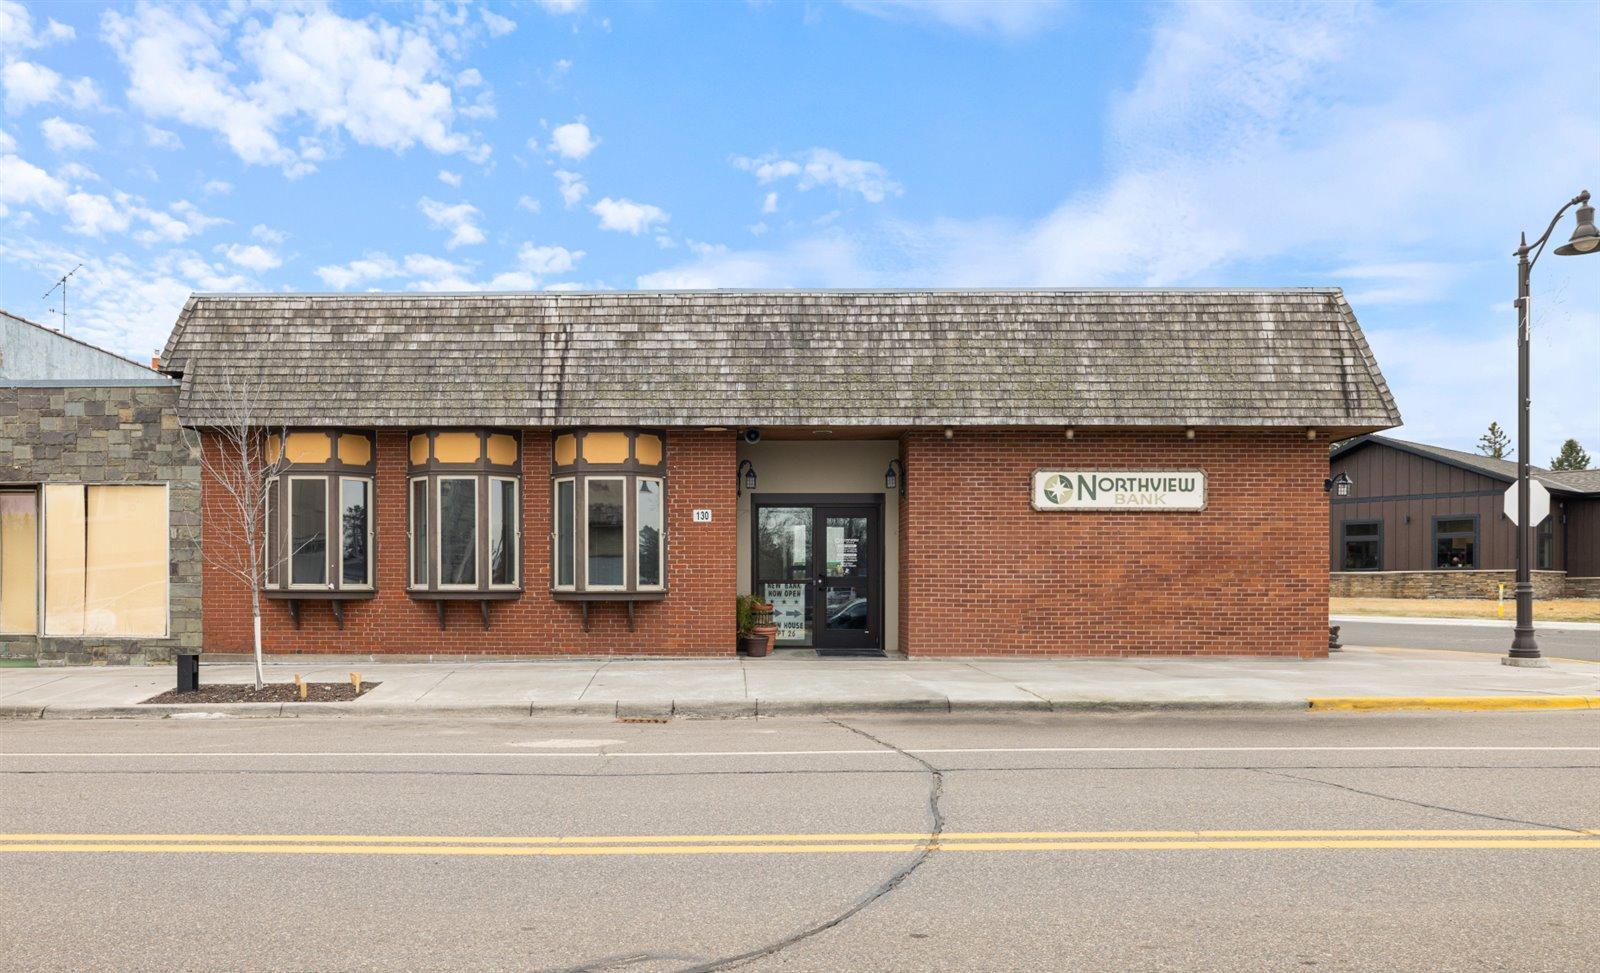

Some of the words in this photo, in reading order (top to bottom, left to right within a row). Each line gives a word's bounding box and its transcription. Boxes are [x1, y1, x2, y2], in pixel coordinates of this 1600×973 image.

[1077, 474, 1195, 500] NORTHVIEW
[1114, 493, 1166, 505] BANK
[696, 511, 709, 520] 130
